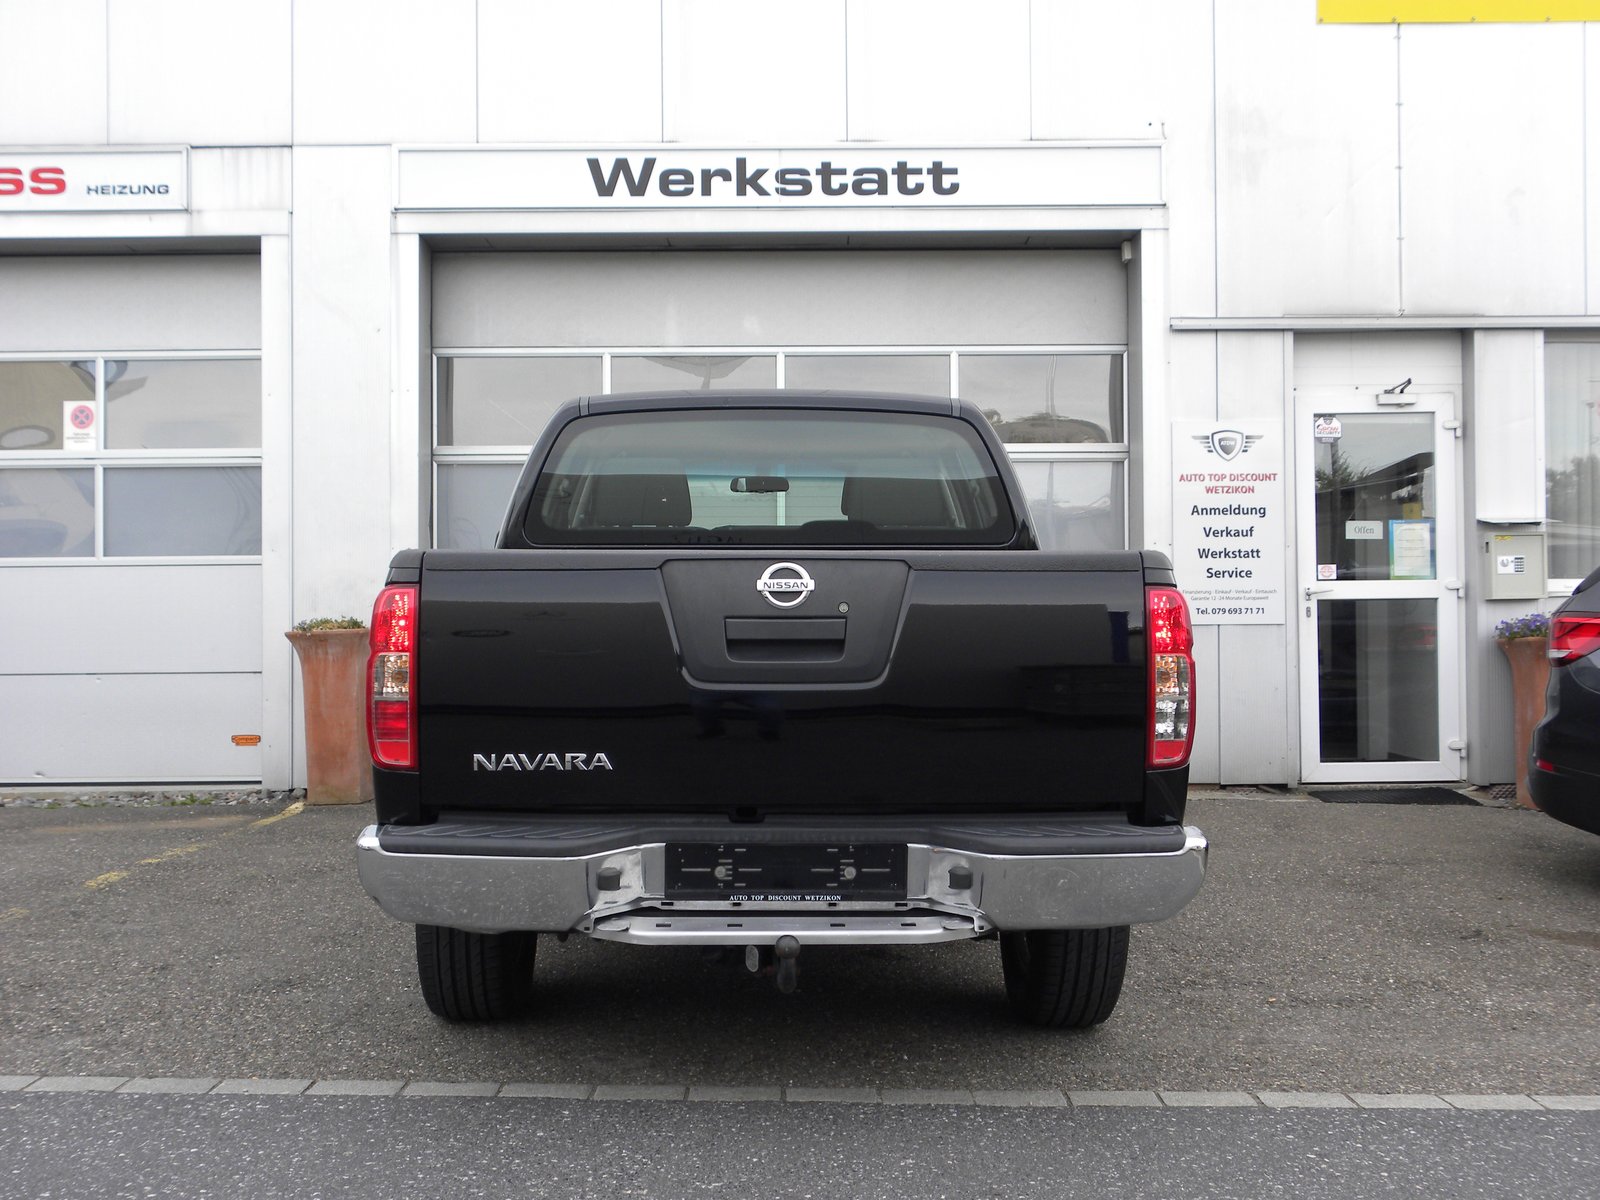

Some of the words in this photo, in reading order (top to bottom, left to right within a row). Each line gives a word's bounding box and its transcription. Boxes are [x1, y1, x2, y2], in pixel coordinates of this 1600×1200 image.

[586, 157, 960, 197] Werkstatt
[86, 184, 169, 195] HEIZUNG
[1179, 473, 1205, 482] AUTO
[1208, 473, 1227, 482] TOP
[1229, 473, 1278, 482] DISCOUNT
[1205, 486, 1255, 494] WETZIKON
[1191, 504, 1267, 518] Anmeldung
[1203, 526, 1254, 538] Verkauf
[1354, 526, 1375, 535] Offen
[1198, 548, 1261, 559] Werkstatt
[1206, 567, 1253, 579] Service
[473, 752, 613, 772] NAVARA
